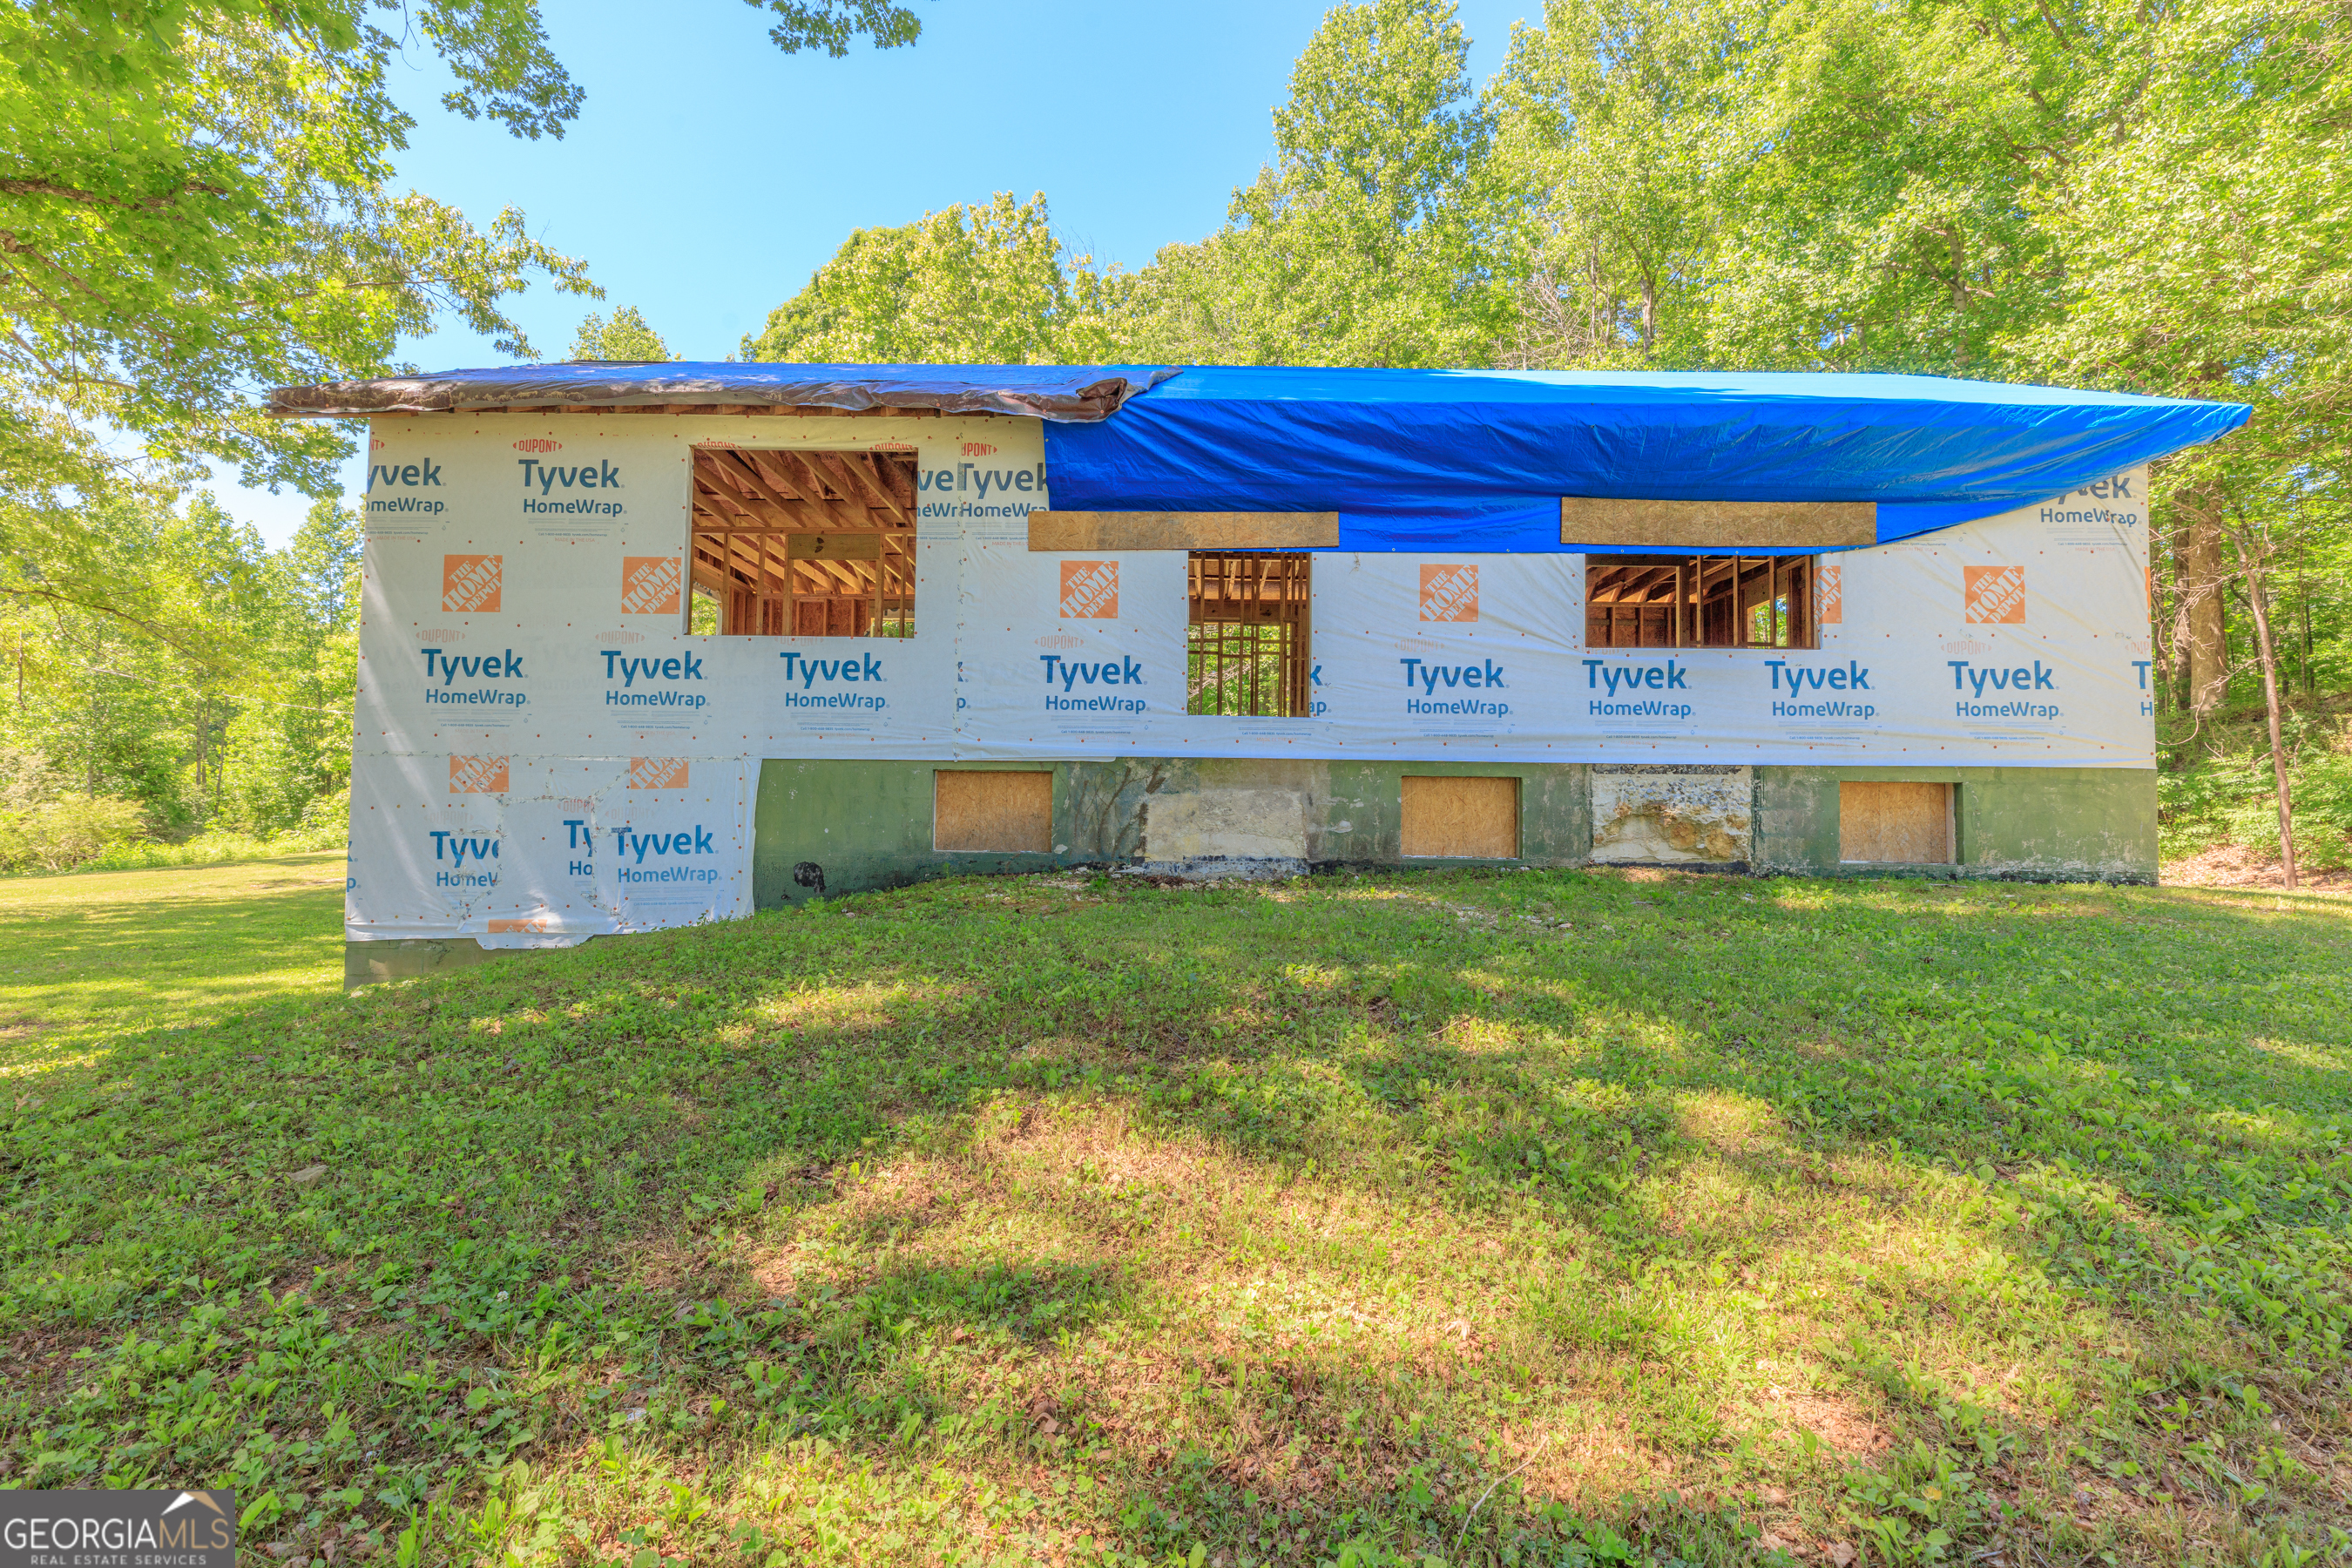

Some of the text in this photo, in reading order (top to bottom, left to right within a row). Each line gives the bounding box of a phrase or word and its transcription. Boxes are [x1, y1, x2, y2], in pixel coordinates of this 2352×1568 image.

[518, 440, 558, 453] DUPONT
[518, 459, 619, 496] Tyvek
[524, 498, 623, 517] HomeWrap
[2040, 508, 2137, 527] HomeWrap
[443, 554, 503, 612] HOME
[449, 560, 475, 584] THE
[628, 563, 653, 586] THE
[1066, 567, 1092, 590] THE
[1426, 570, 1450, 593] THE
[1970, 572, 1997, 596] THE
[466, 577, 503, 612] DEPOT
[622, 558, 681, 614] HOME
[645, 579, 681, 614] DEPOT
[1060, 561, 1119, 618] HOME
[1420, 564, 1478, 622] HOME
[1965, 566, 2025, 624] HOME
[1083, 583, 1119, 618] DEPOT
[1443, 586, 1478, 622] DEPOT
[1988, 588, 2025, 624] DEPOT
[422, 629, 461, 643] DUPONT
[601, 631, 639, 645] DUPONT
[1040, 635, 1079, 649] DUPONT
[1947, 641, 1986, 654] DUPONT
[421, 648, 524, 686] Tyvek
[600, 651, 703, 687] Tyvek
[780, 652, 882, 689] Tyvek
[1040, 655, 1142, 692] Tyvek
[1400, 659, 1504, 695] Tyvek
[1582, 659, 1687, 697] Tyvek
[1764, 660, 1870, 698] Tyvek
[1948, 660, 2054, 698] Tyvek
[426, 688, 526, 707] HomeWrap
[606, 691, 706, 709] HomeWrap
[786, 693, 885, 711] HomeWrap
[1046, 695, 1146, 714] HomeWrap
[1407, 699, 1509, 718] HomeWrap
[1589, 700, 1692, 720] HomeWrap
[1772, 700, 1875, 720] HomeWrap
[1957, 702, 2058, 720] HomeWrap
[611, 824, 714, 864] Tyvek
[618, 866, 718, 884] HomeWrap
